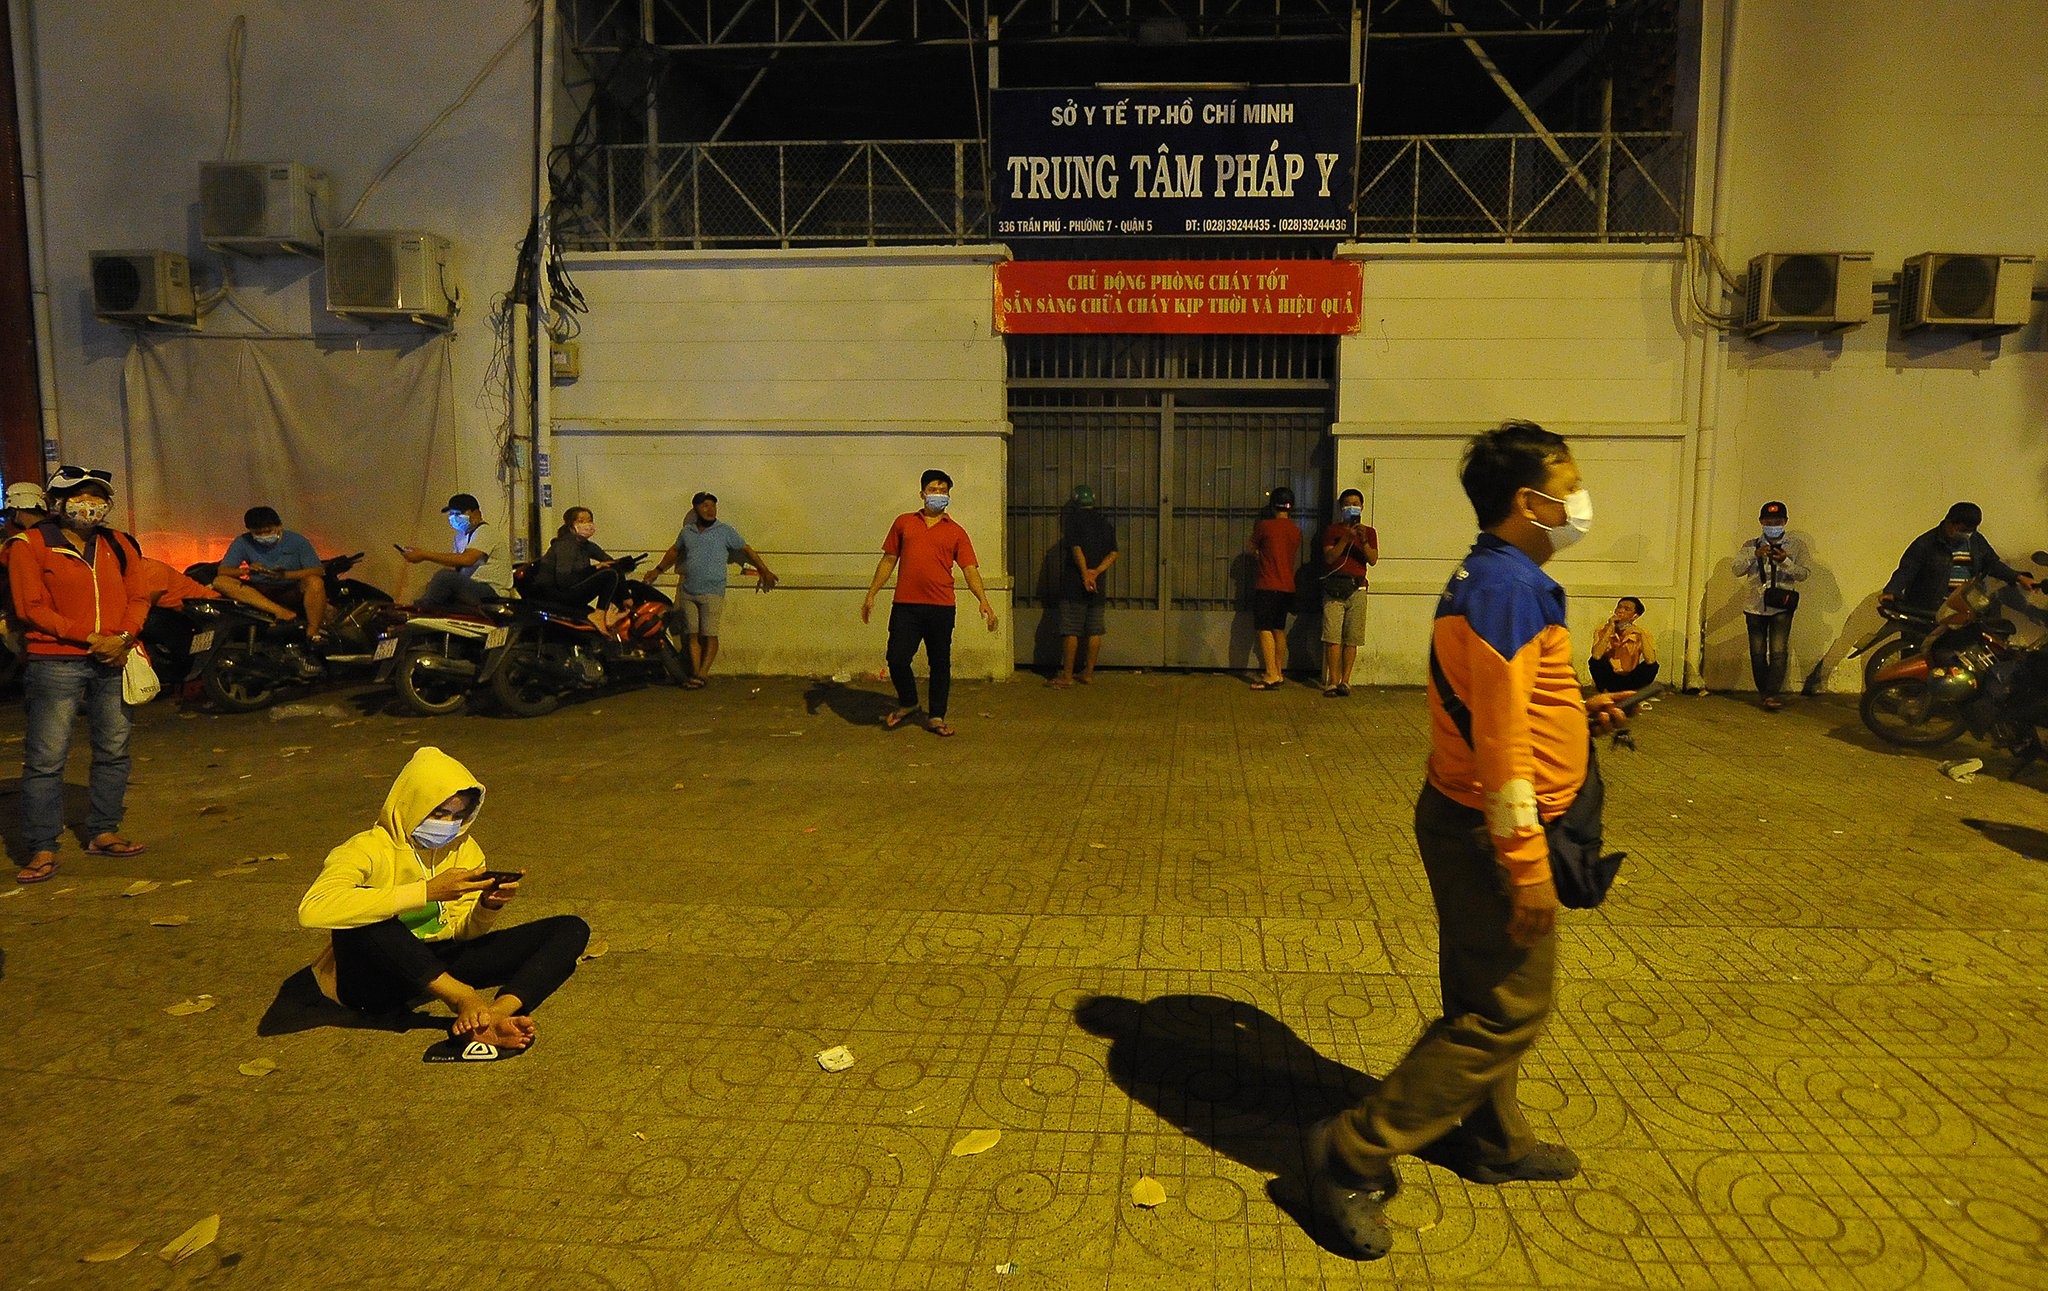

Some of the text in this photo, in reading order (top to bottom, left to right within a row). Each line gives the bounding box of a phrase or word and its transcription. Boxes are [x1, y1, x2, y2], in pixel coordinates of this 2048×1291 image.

[1051, 97, 1294, 127] SỞ Y TẾ TP.HỒ CHÍ MINH
[1007, 139, 1339, 199] TRUNG TÂM PHÁP Y
[998, 220, 1015, 232] 336
[1043, 217, 1061, 232] PHÚ
[1069, 216, 1105, 232] PHƯỜNG
[1107, 220, 1112, 232] 7
[1121, 217, 1145, 234] QUẬN
[1147, 220, 1153, 232] 5
[1202, 218, 1270, 232] (028)39244435
[1278, 218, 1347, 232] (028)39244436
[1067, 267, 1289, 294] CHỦ ĐỘNG PHÒNG CHÁY TỐT
[1036, 293, 1077, 313] SÀNG
[1081, 293, 1124, 313] CHỮA
[1127, 294, 1171, 313] CHÁY
[1174, 297, 1204, 318] KỊP
[1208, 293, 1248, 314] THỜI
[1252, 294, 1273, 313] VÀ
[1278, 294, 1316, 318] HIỆU
[1320, 290, 1354, 318] QUẢ
